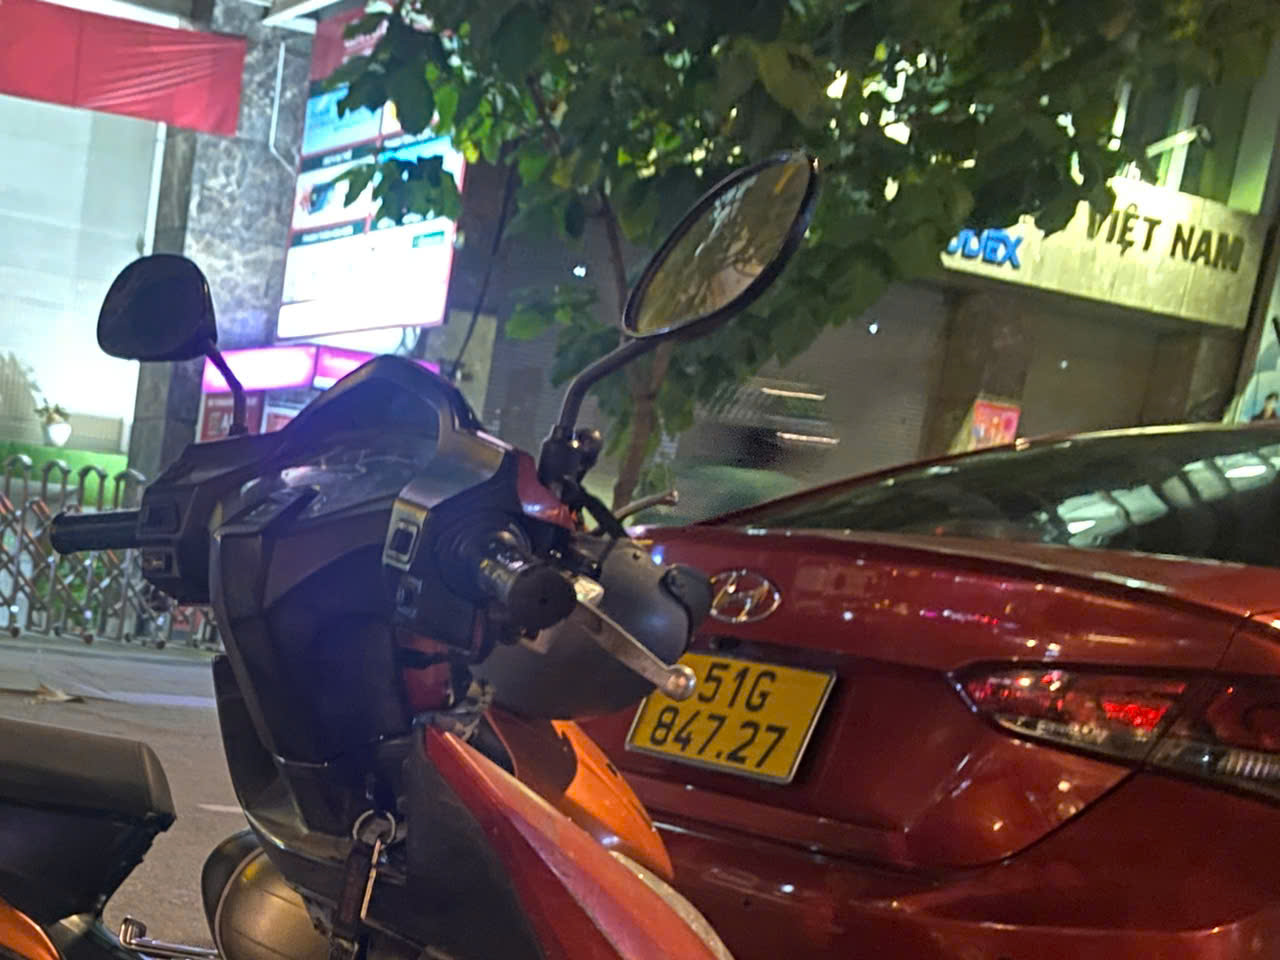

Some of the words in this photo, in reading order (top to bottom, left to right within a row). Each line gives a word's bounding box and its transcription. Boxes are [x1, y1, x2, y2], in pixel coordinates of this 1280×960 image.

[1087, 202, 1163, 257] VIỆT
[1170, 223, 1247, 273] NAM
[697, 661, 777, 712] 51G
[649, 705, 789, 768] 847.27
